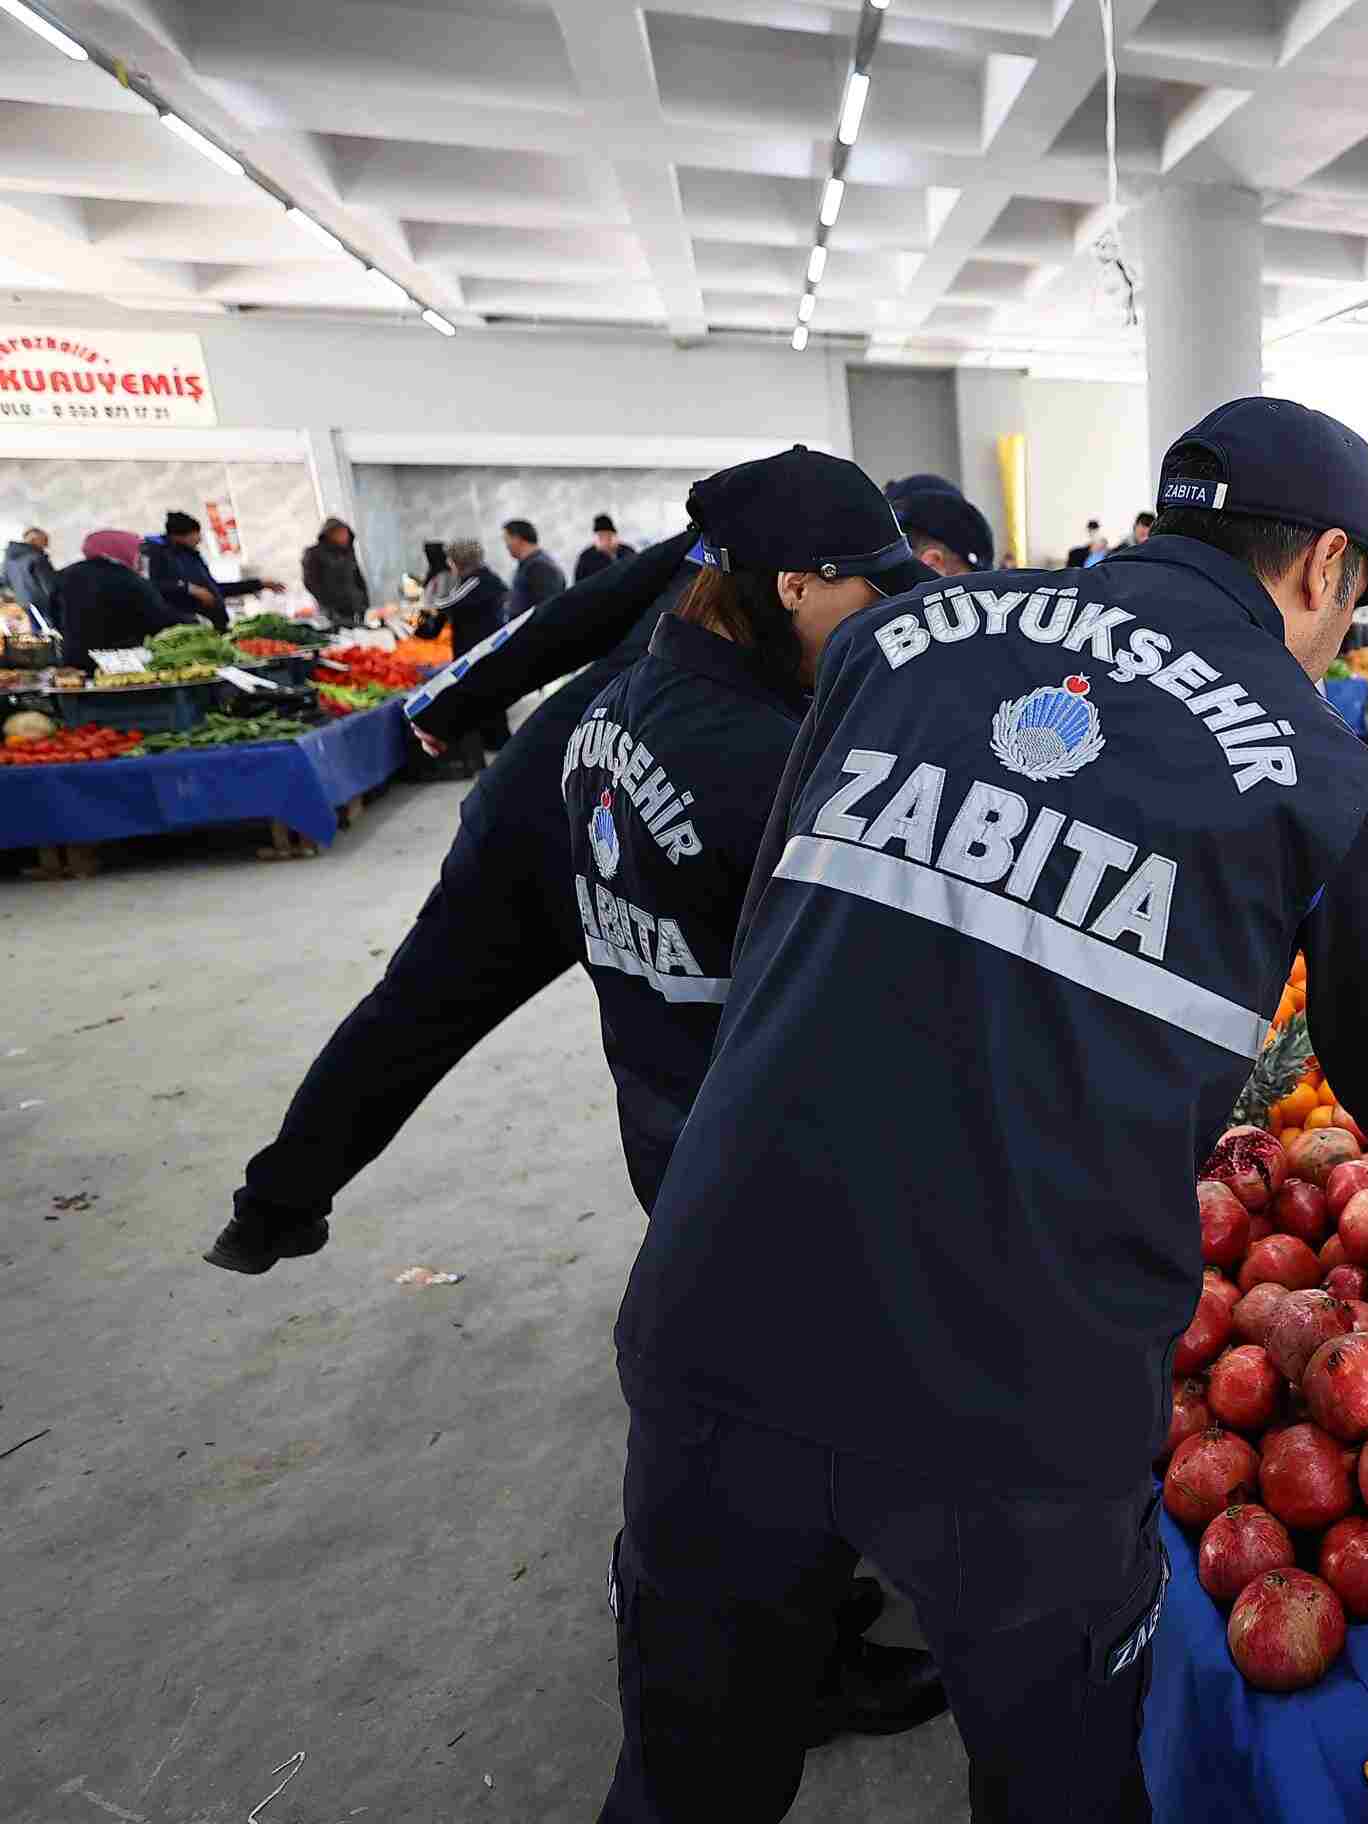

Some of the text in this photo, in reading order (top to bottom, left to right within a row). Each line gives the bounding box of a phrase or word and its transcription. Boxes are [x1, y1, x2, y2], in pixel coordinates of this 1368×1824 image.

[0, 368, 204, 404] KURUYEMİŞ
[1165, 484, 1206, 502] ZABITA
[874, 586, 1298, 793] BÜYÜKŞEHİR
[812, 748, 1178, 961] ZABITA
